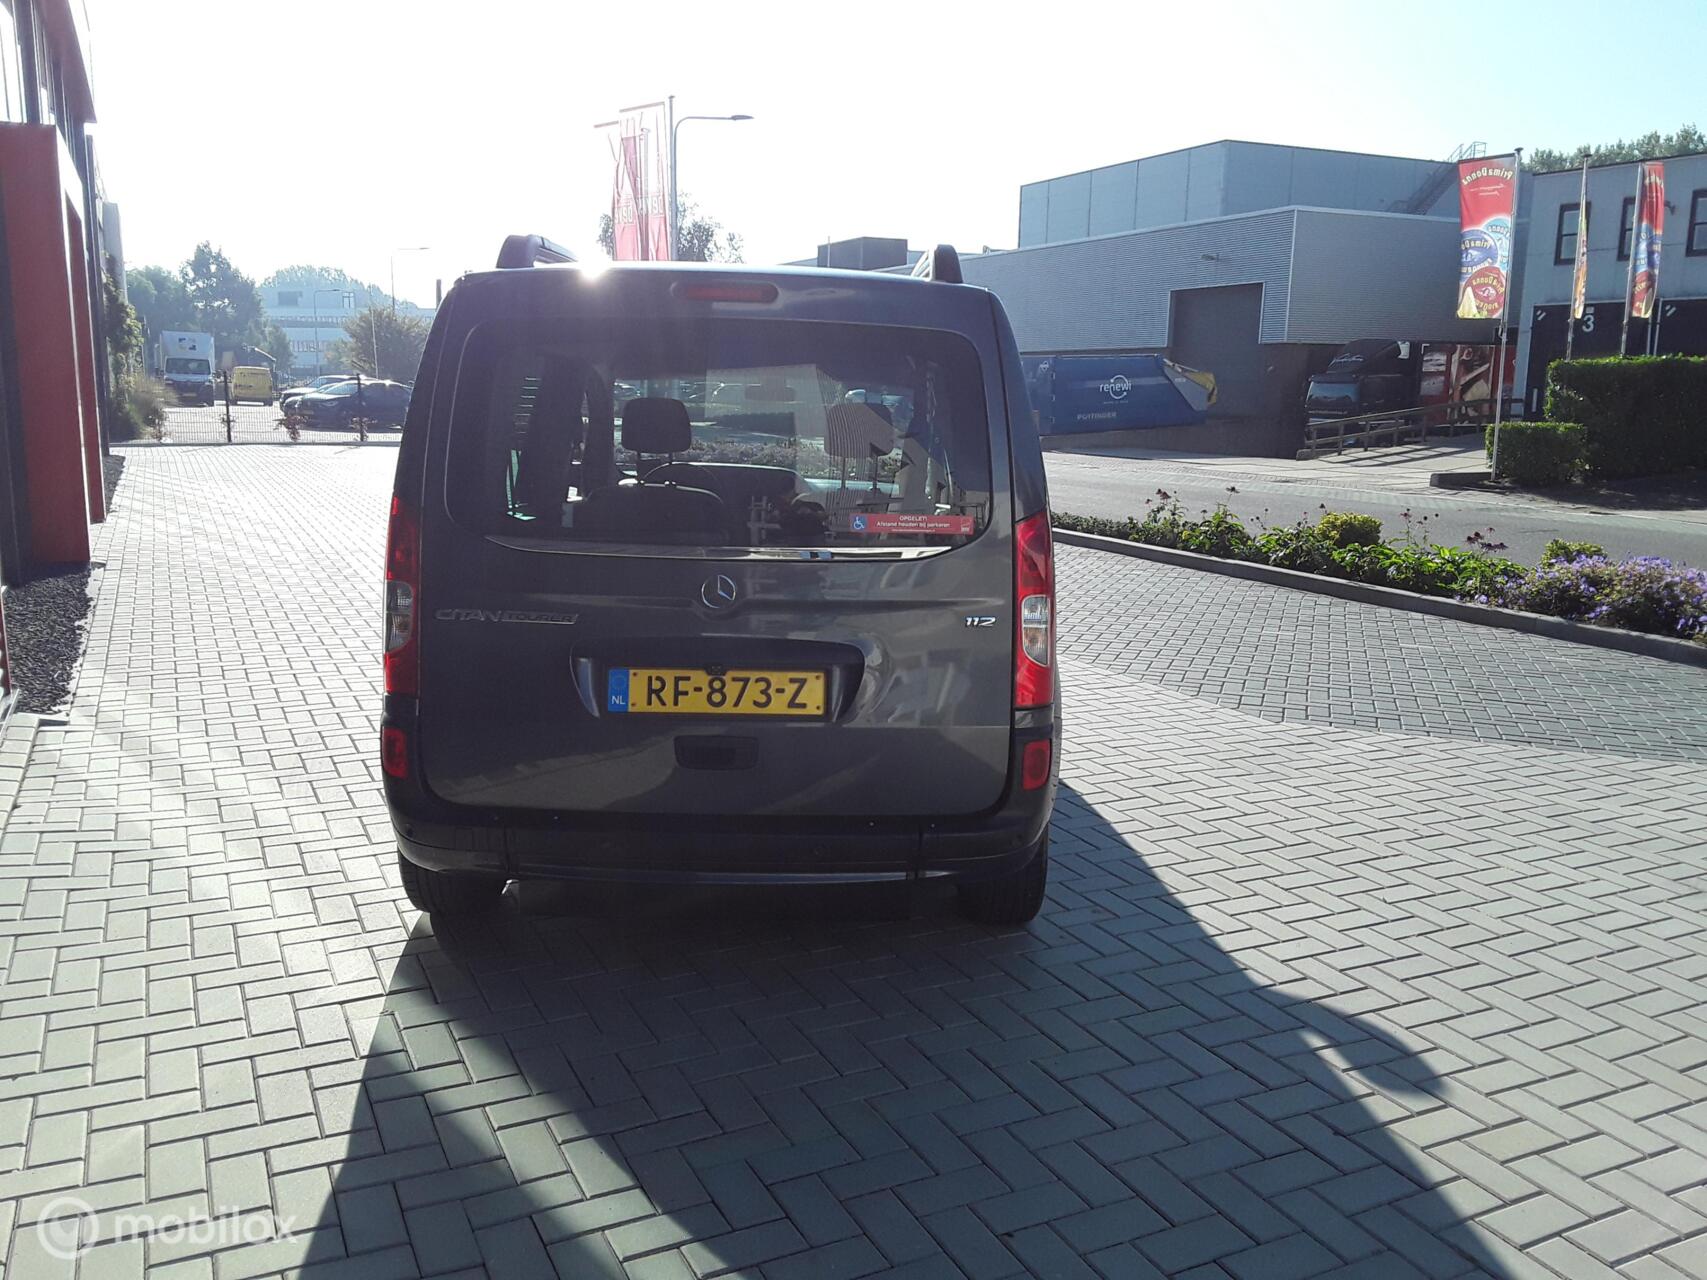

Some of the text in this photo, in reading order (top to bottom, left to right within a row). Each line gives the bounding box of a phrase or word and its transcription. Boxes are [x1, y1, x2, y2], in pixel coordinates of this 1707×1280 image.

[1582, 314, 1595, 333] 3
[1100, 380, 1132, 392] renewi
[435, 608, 501, 622] CITAN
[965, 616, 996, 627] 112
[646, 675, 808, 709] RF-873-Z
[611, 696, 626, 705] NL
